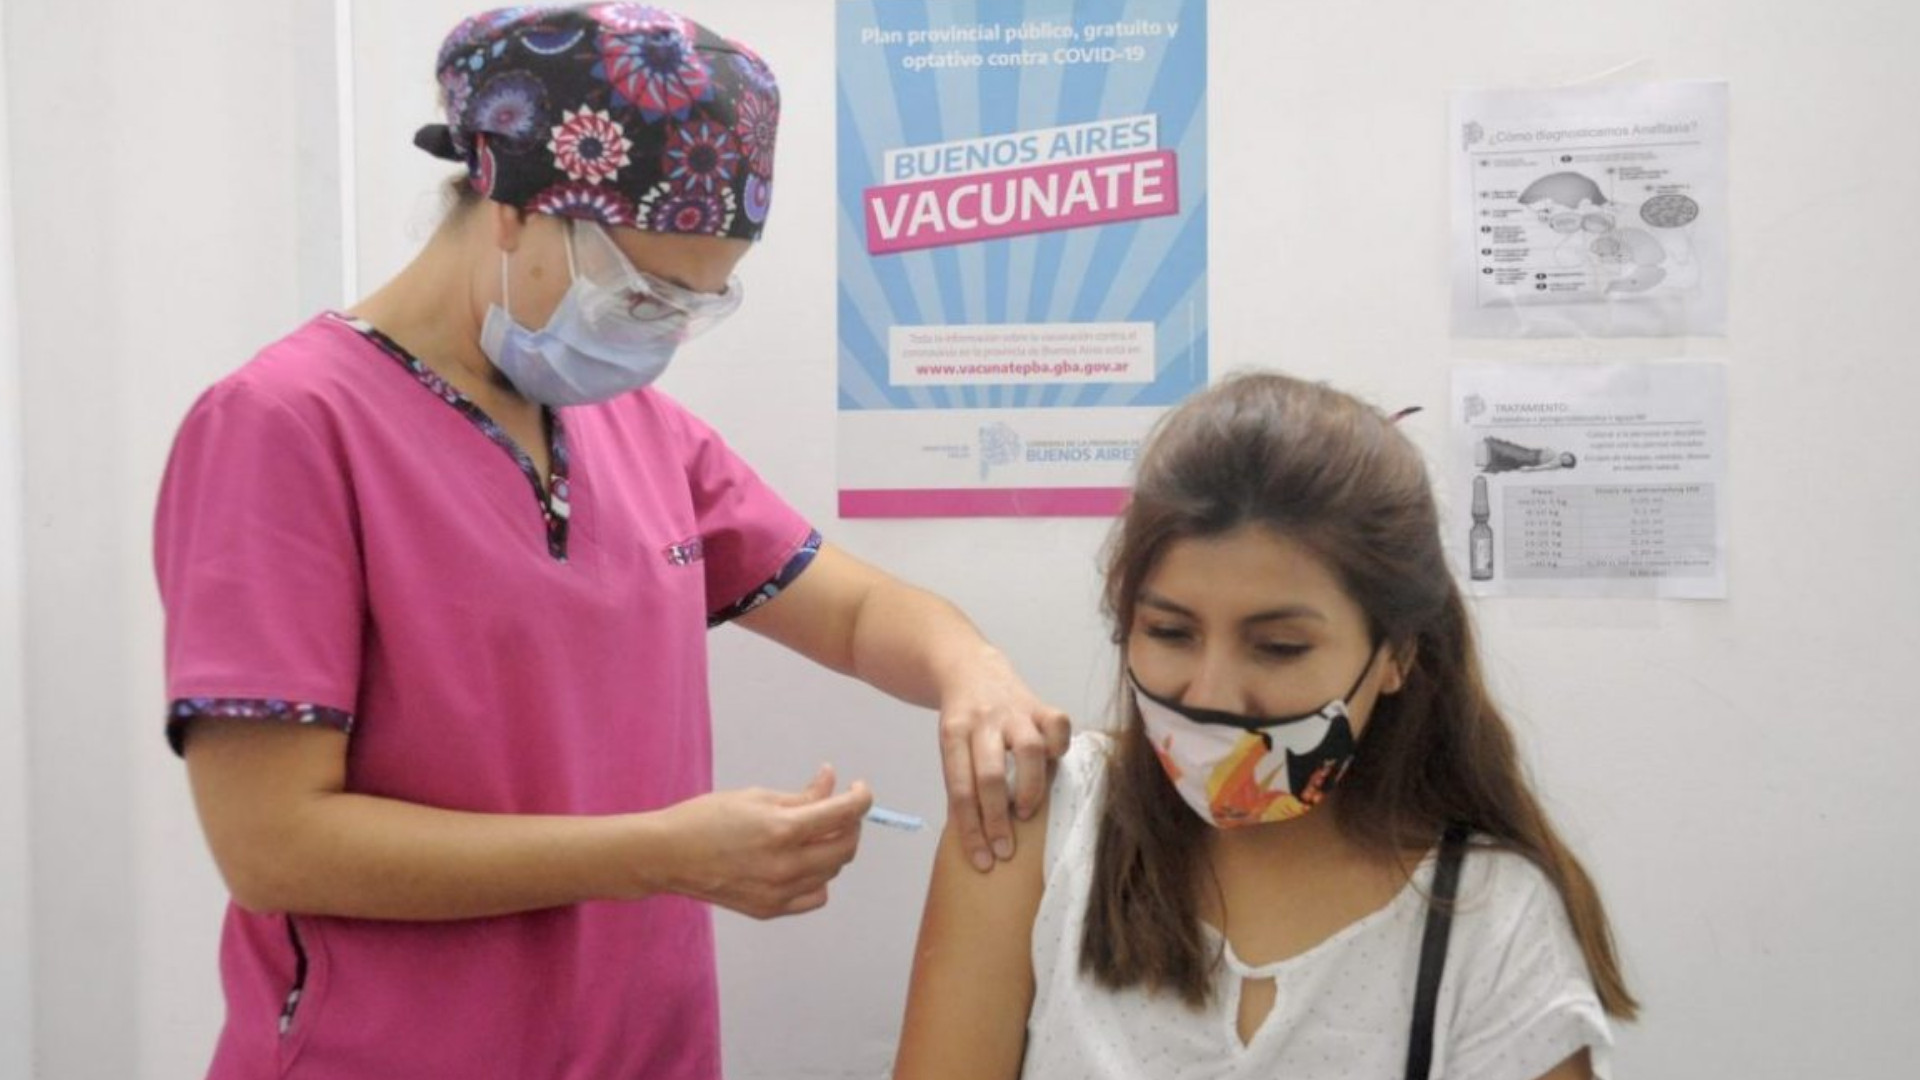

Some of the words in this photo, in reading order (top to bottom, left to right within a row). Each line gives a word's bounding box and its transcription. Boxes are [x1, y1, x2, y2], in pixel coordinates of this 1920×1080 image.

[861, 26, 902, 44] Plan
[908, 23, 1000, 47] provincial
[1006, 20, 1080, 44] público,
[1084, 19, 1162, 42] gratuito
[1166, 22, 1179, 39] y
[902, 49, 983, 72] optativo
[987, 49, 1048, 67] contra
[1054, 45, 1145, 65] COVID-19
[894, 135, 1039, 181] BUENOS
[1050, 120, 1152, 159] AIRES
[871, 159, 1166, 241] VACUNATE
[915, 359, 1129, 377] www.vacunatepba.gba.gov.ar
[1026, 447, 1092, 462] BUENOS
[1094, 447, 1141, 461] AIRES
